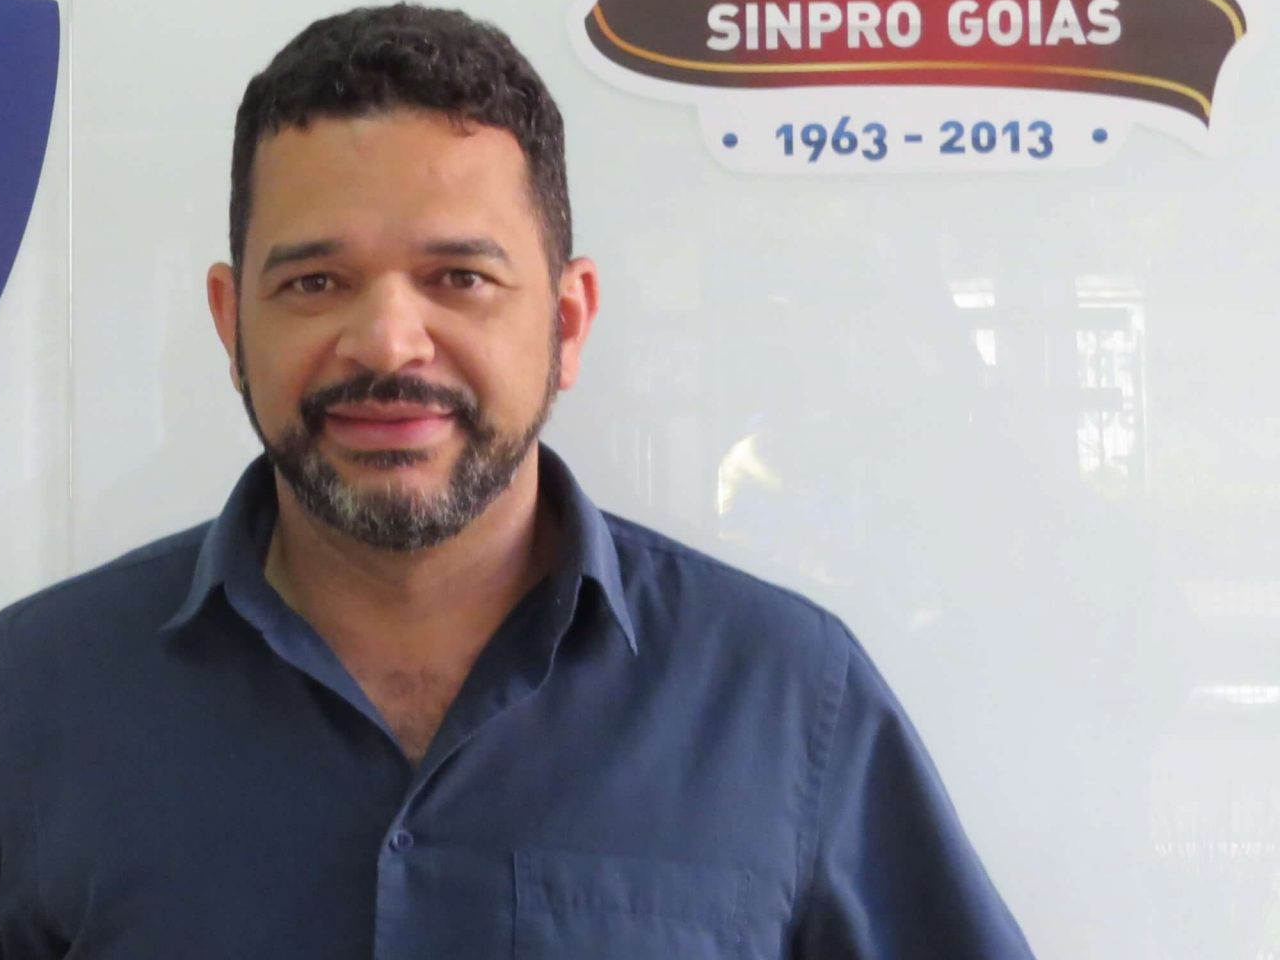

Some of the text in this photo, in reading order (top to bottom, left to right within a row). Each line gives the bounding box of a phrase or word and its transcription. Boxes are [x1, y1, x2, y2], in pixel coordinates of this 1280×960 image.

[706, 0, 922, 51] SINPRO
[775, 116, 888, 163] 1963
[939, 120, 1054, 160] 2013
